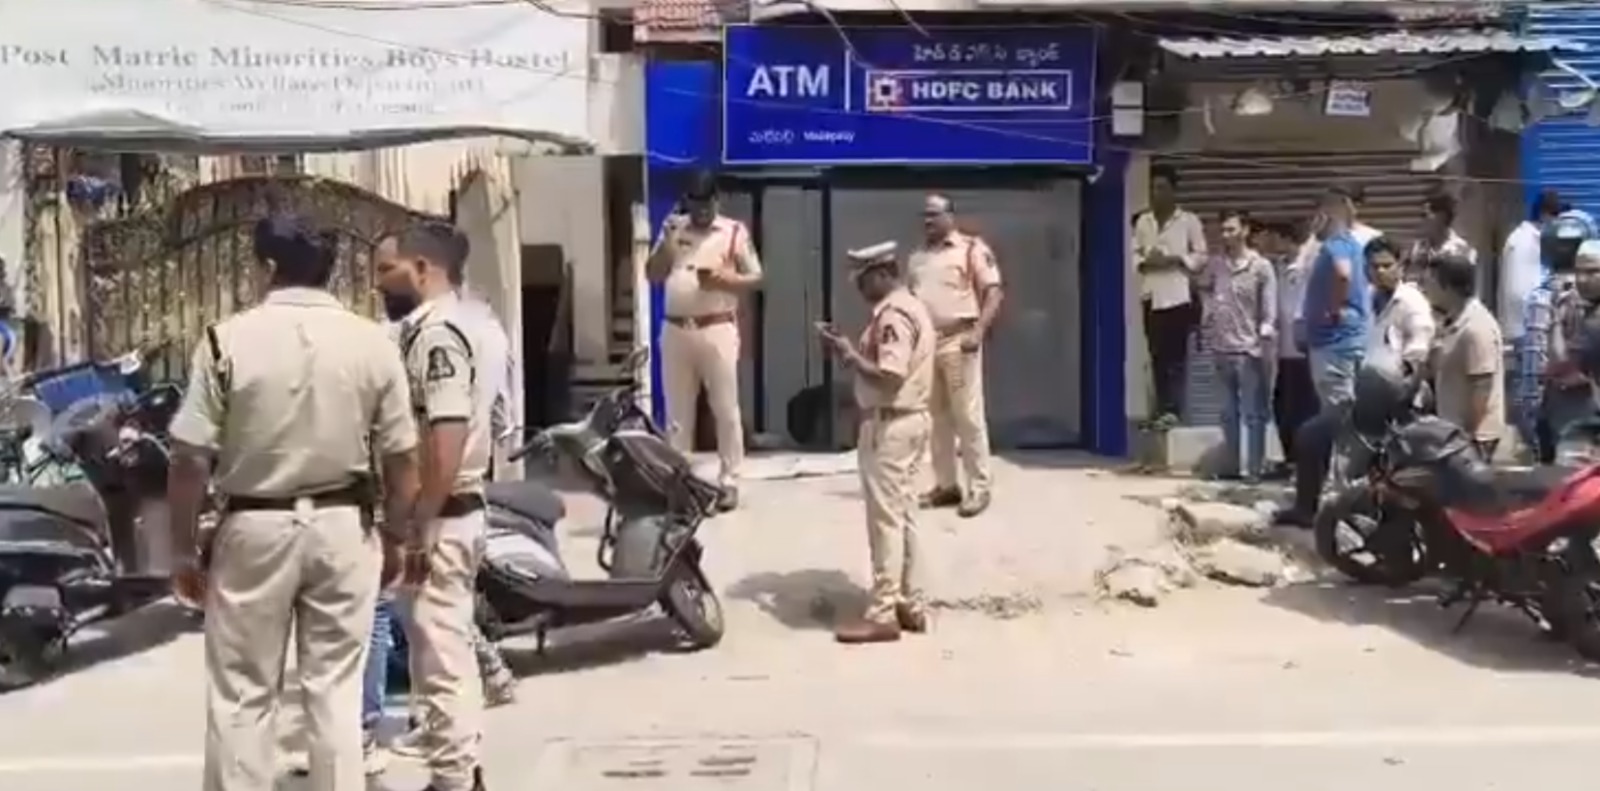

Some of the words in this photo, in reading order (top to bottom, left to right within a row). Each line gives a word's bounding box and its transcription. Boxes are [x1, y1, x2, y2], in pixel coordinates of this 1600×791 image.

[1, 45, 69, 66] Post
[93, 45, 196, 67] Matric
[210, 46, 375, 68] Minorities
[386, 49, 460, 74] Boys
[469, 49, 569, 68] Hostel
[747, 65, 830, 97] ATM
[911, 81, 980, 100] HDFC
[987, 80, 1057, 99] BANK
